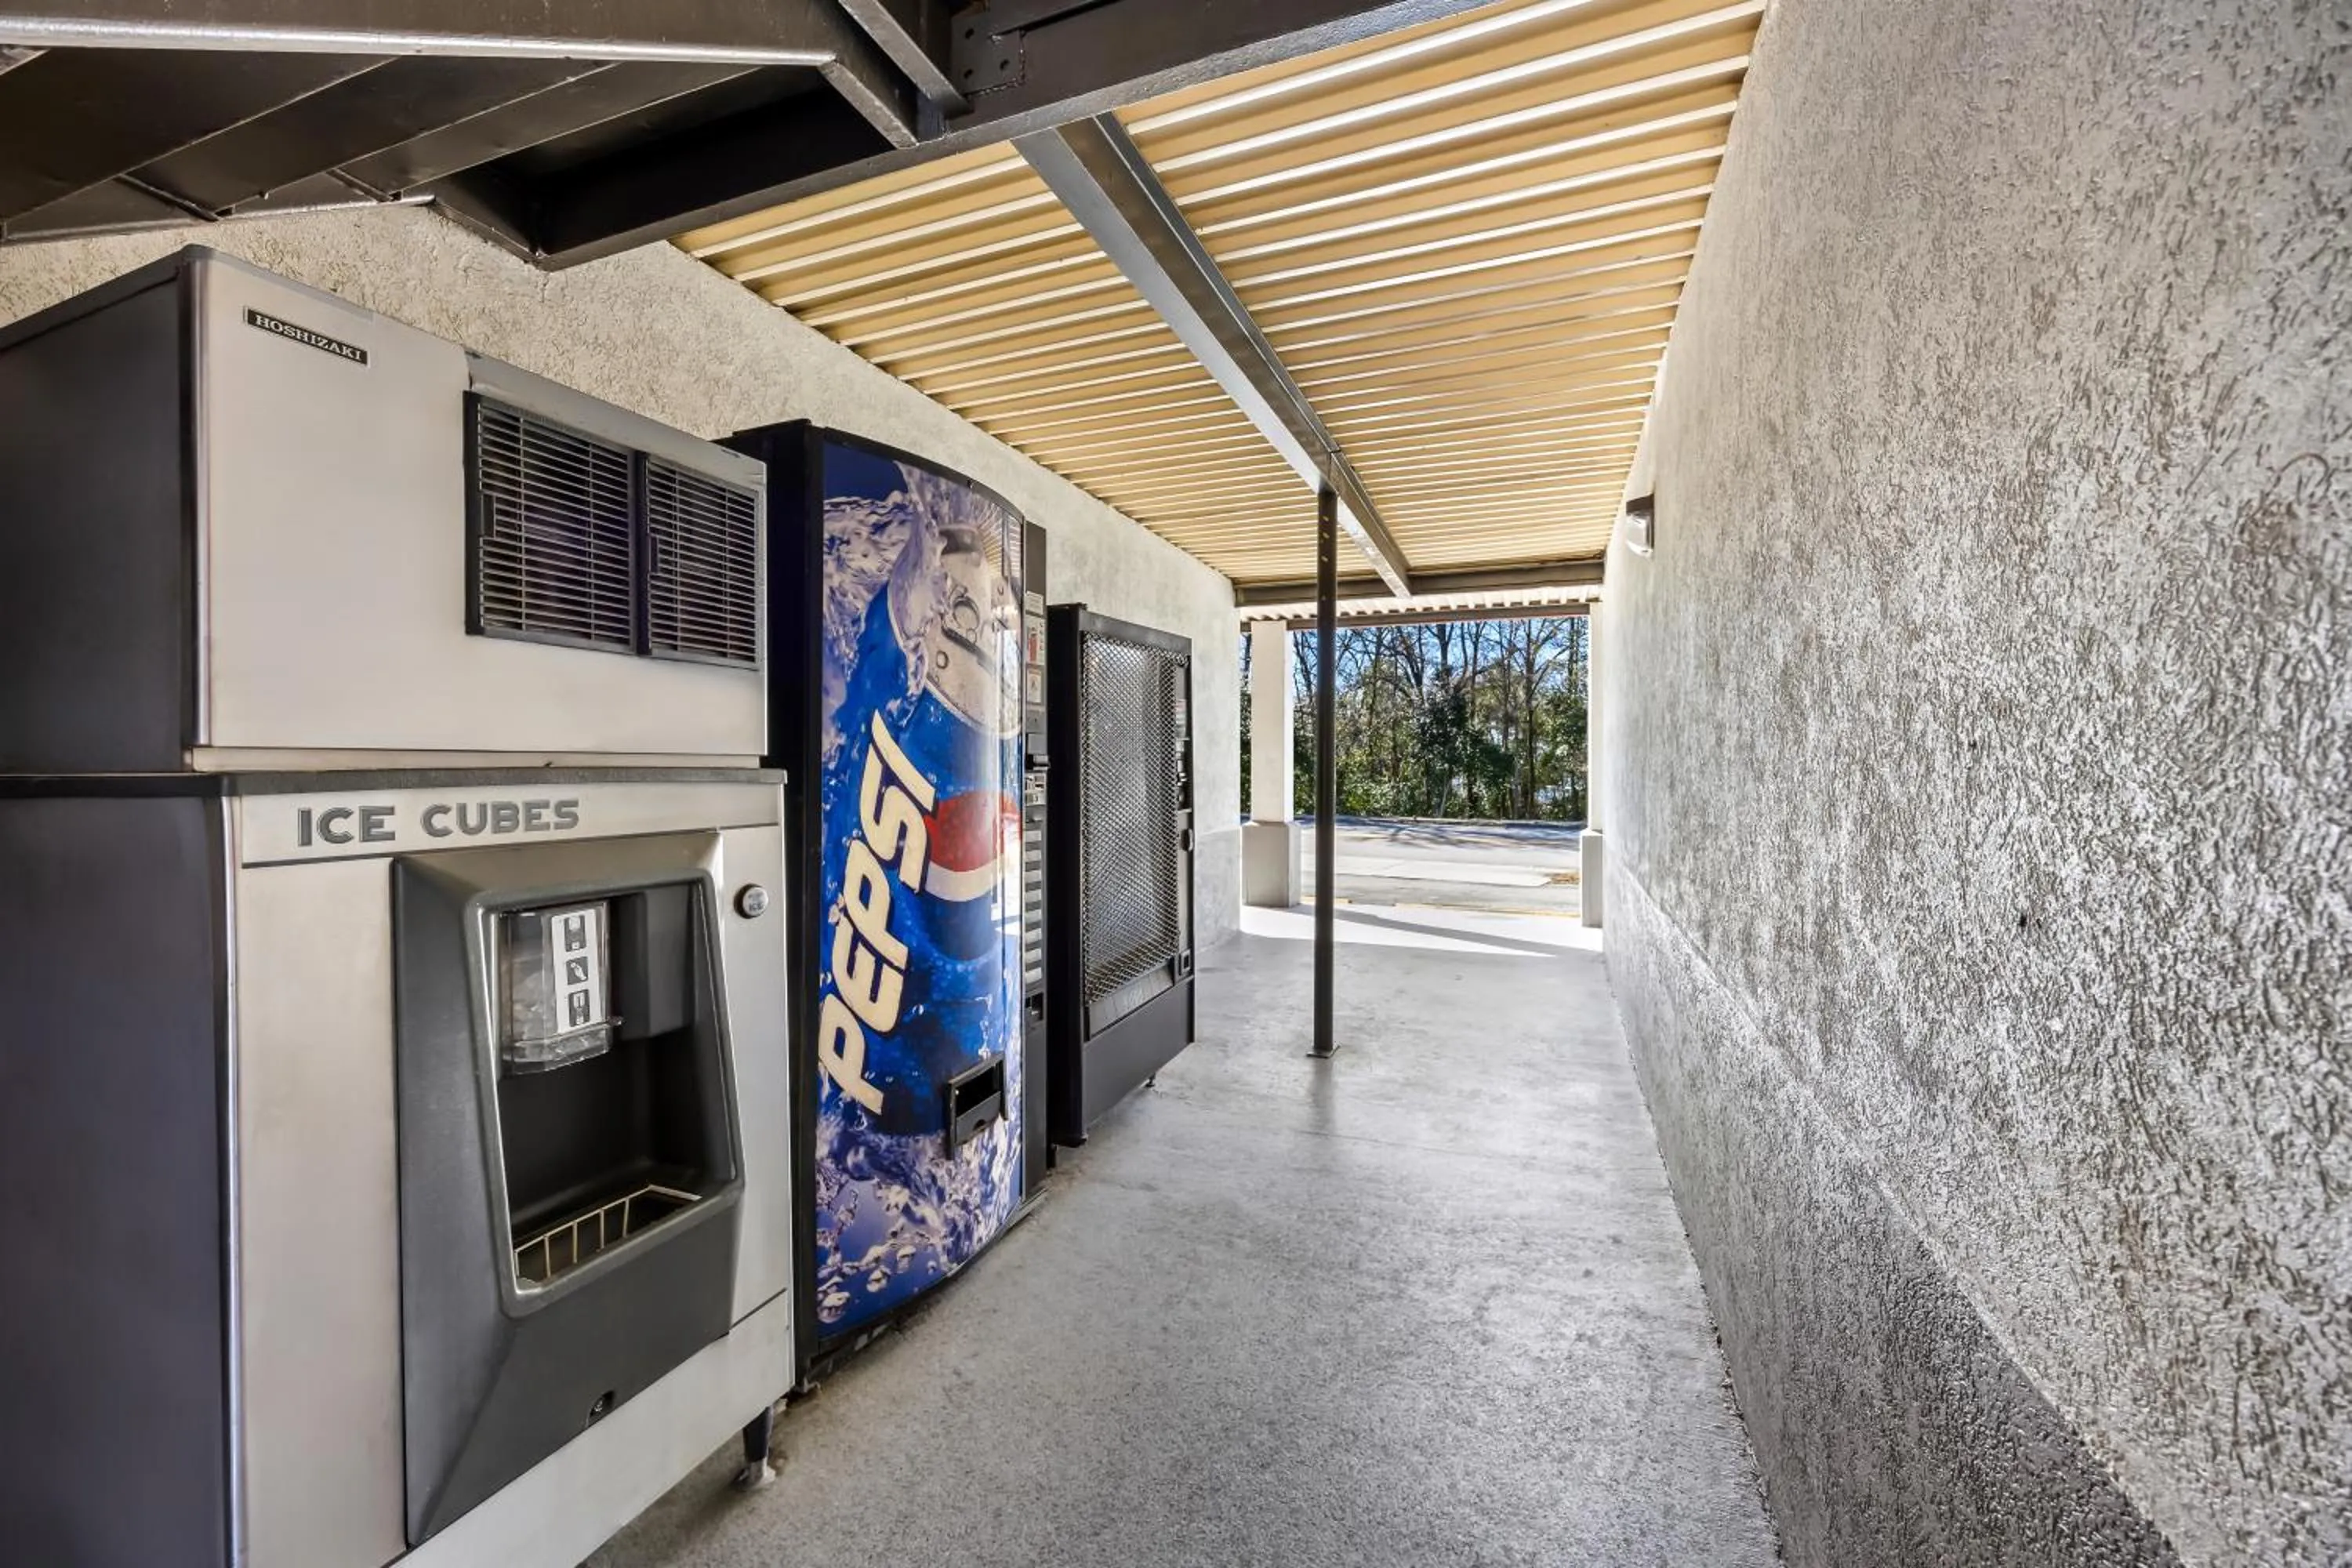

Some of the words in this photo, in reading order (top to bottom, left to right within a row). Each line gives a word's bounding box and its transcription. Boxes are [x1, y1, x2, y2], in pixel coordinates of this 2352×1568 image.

[255, 314, 361, 360] HOSHIZAKI
[297, 806, 395, 847] ICE
[420, 800, 579, 837] CUBES
[818, 709, 936, 1115] PEPSI
